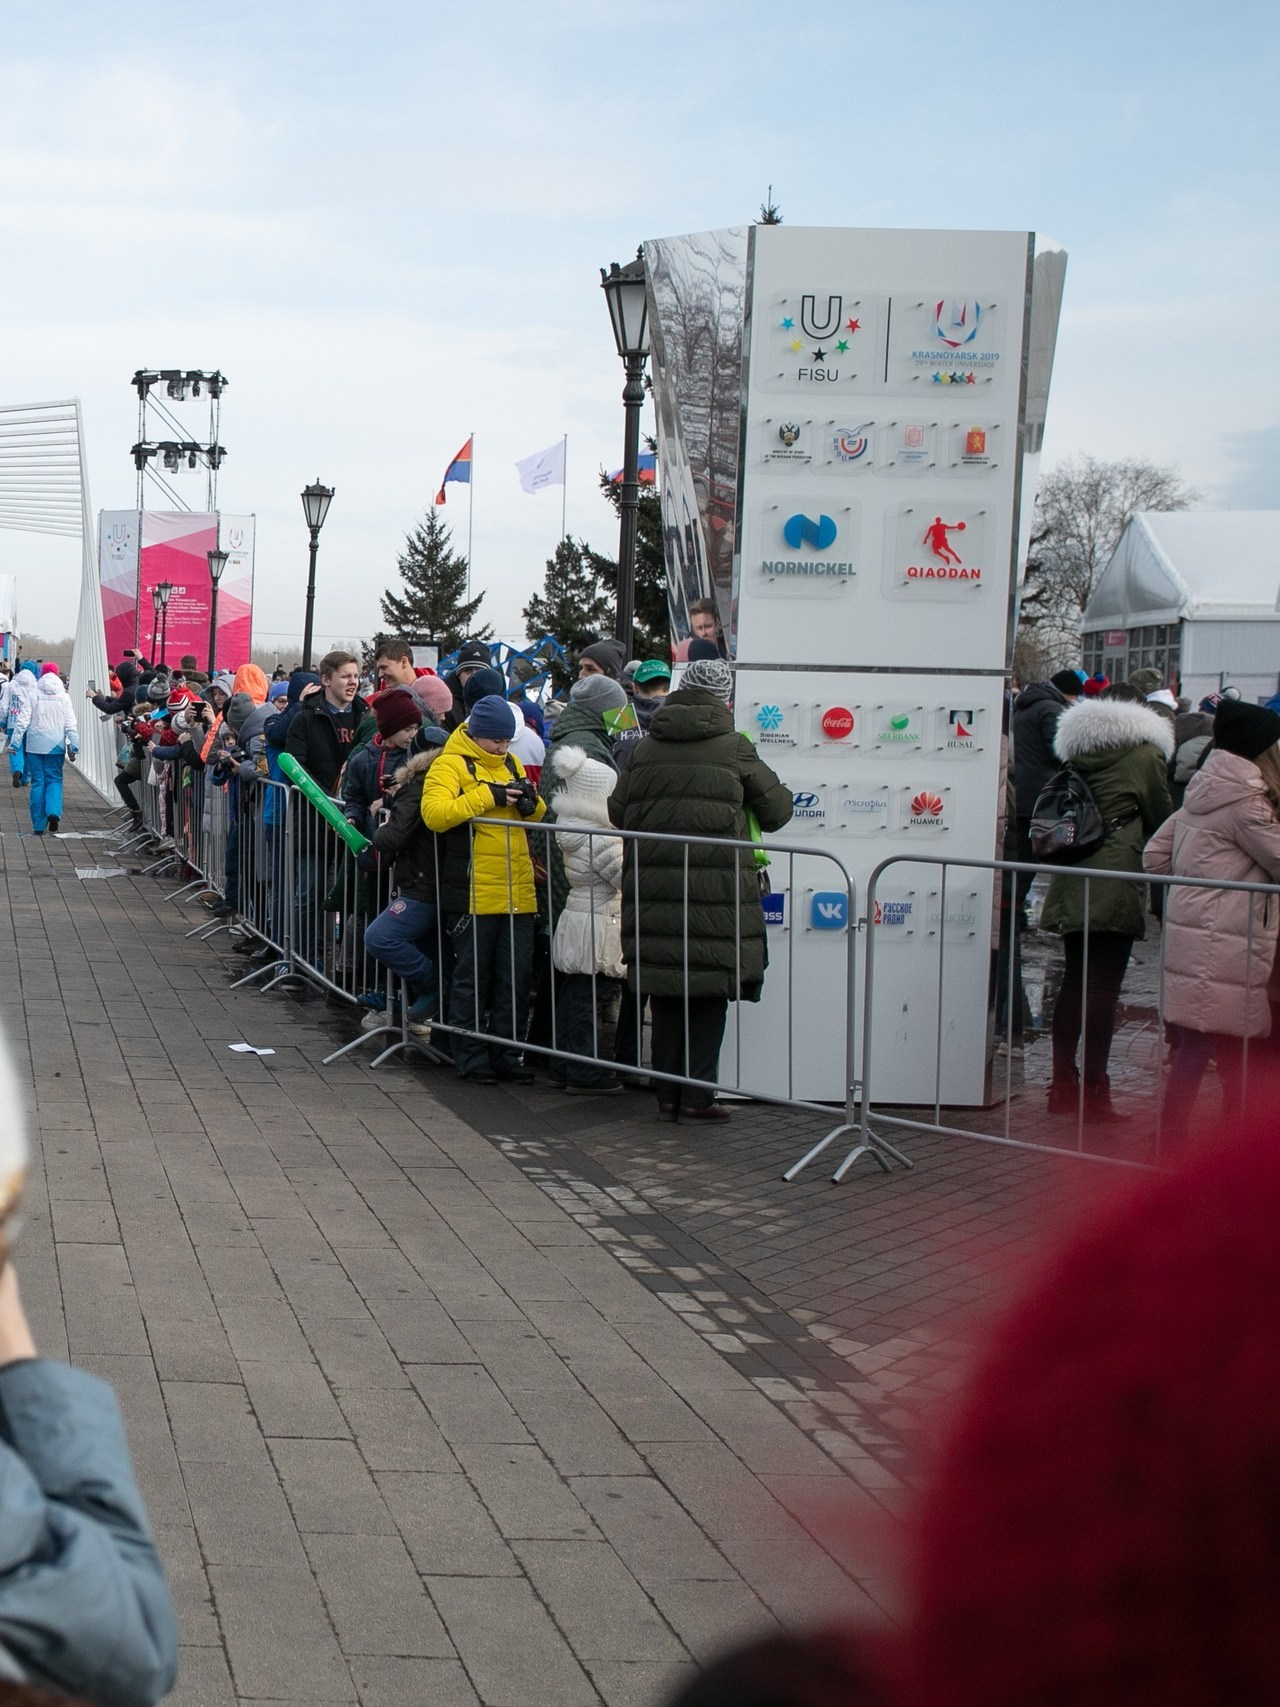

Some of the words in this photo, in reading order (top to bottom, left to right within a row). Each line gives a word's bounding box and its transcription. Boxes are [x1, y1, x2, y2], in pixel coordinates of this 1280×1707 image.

[912, 351, 978, 360] KRASNOYARSK
[980, 353, 1000, 361] 2019
[798, 368, 839, 382] FISU
[761, 561, 857, 576] NORNICKEL
[907, 567, 981, 579] QIAODAN
[823, 718, 853, 728] Coca-Cola
[878, 732, 920, 741] SBERBANK
[947, 741, 975, 749] RUSAL
[793, 810, 825, 818] UNDAI
[910, 818, 944, 826] HUAWEI
[817, 903, 842, 919] VK
[883, 903, 912, 914] РУССКОЕ
[763, 912, 782, 920] ass
[883, 914, 905, 925] РАДИО
